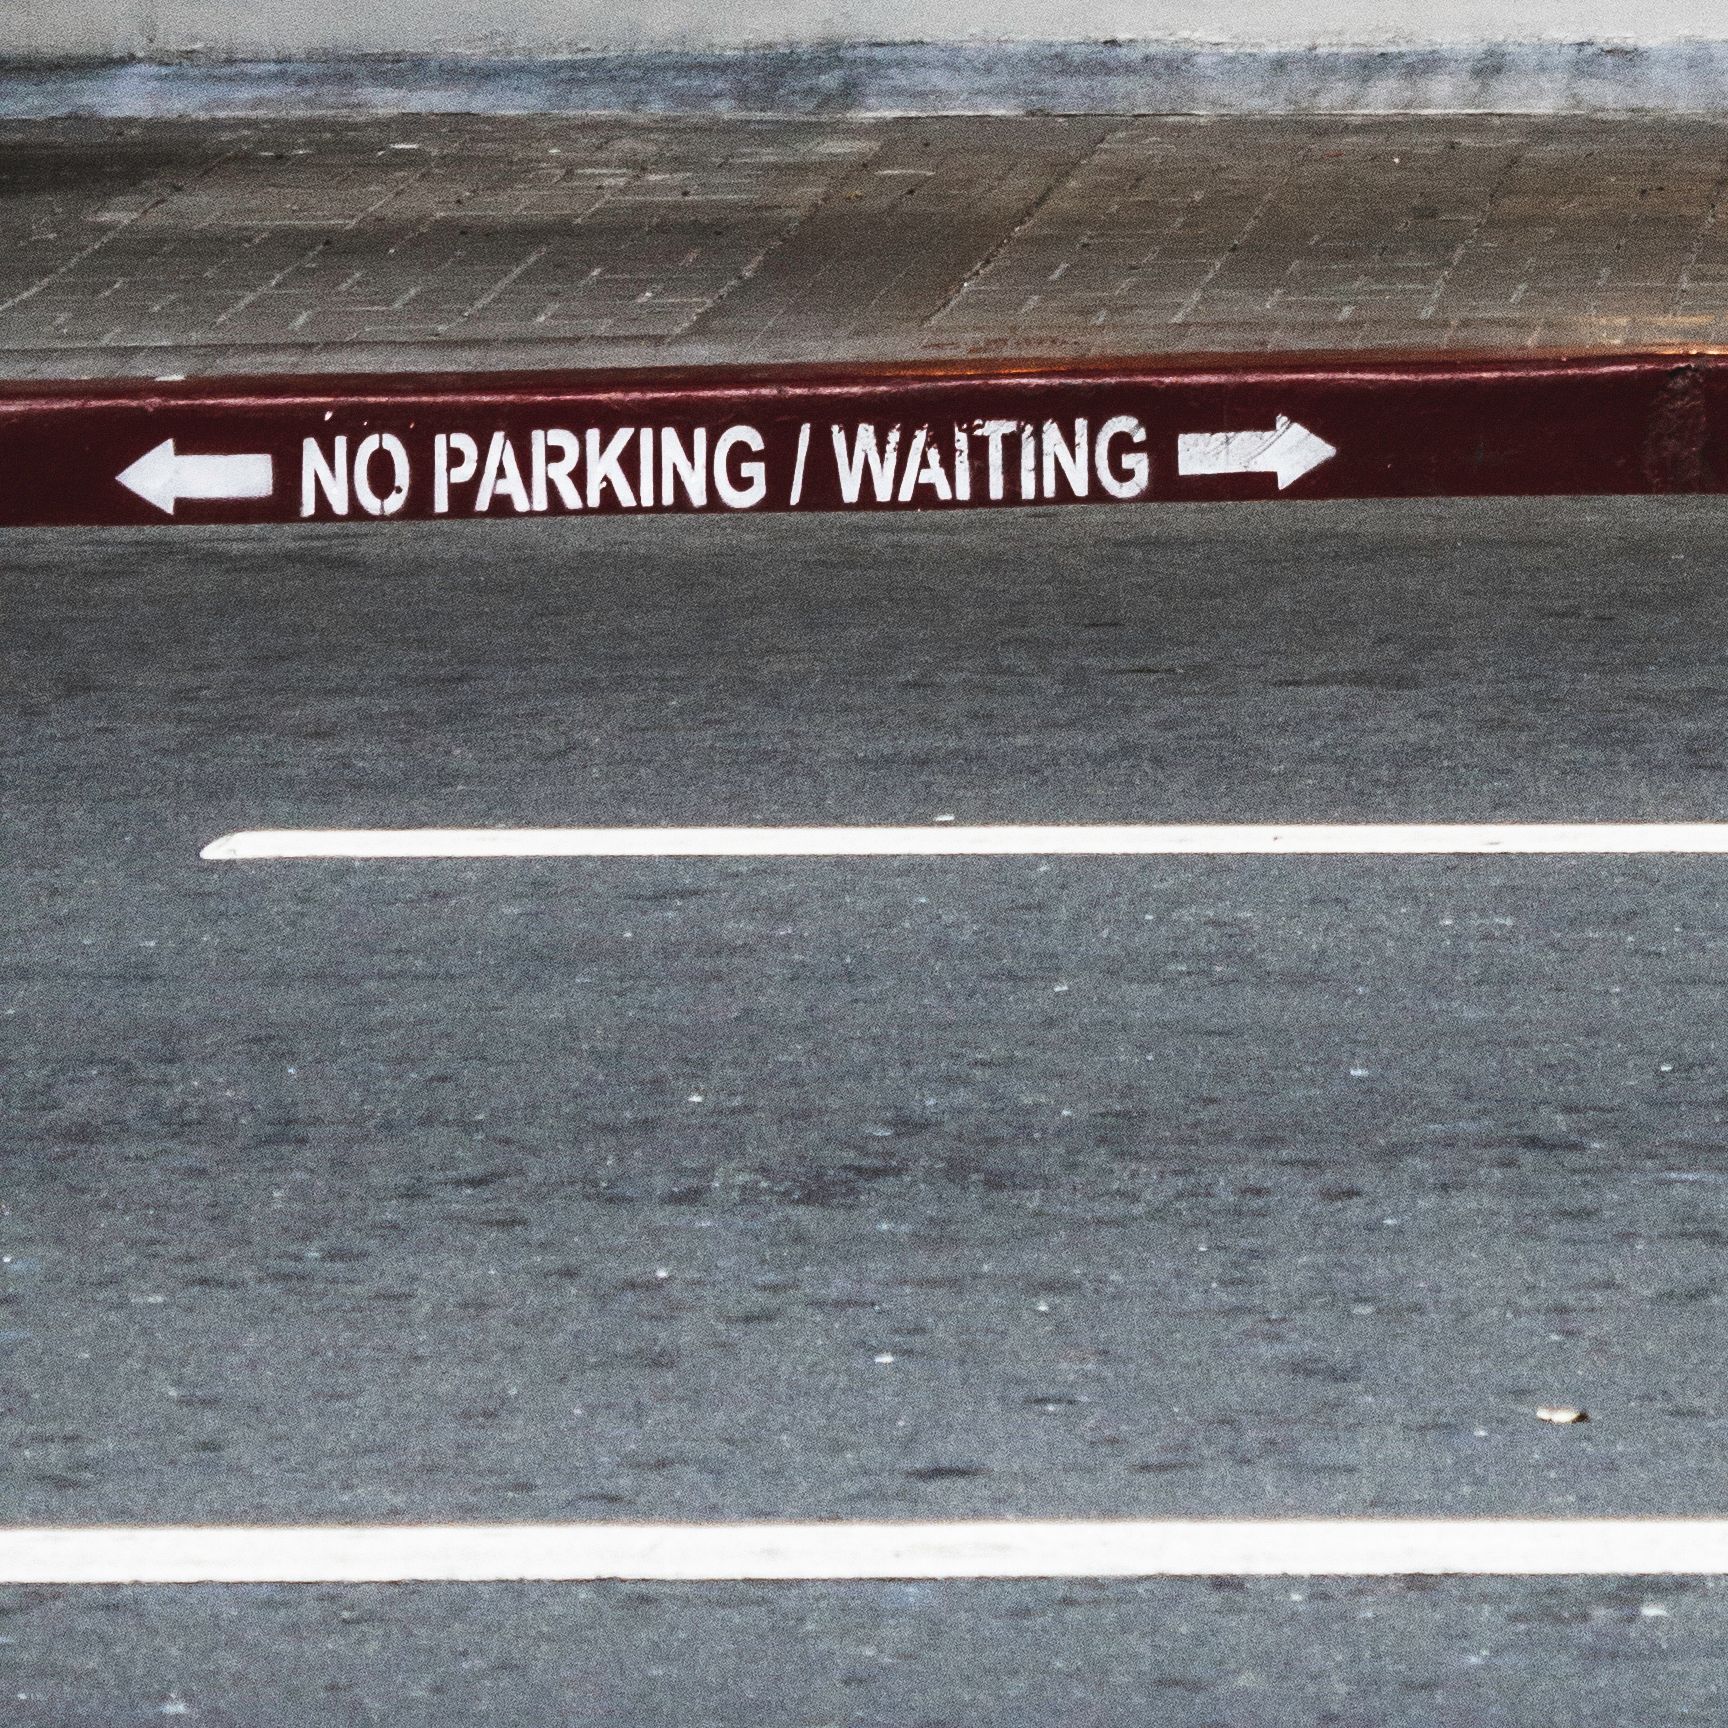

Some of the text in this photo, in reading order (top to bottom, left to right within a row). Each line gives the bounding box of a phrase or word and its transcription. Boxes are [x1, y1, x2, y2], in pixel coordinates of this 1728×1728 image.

[301, 416, 1150, 518] NO PARKING / WAITING
